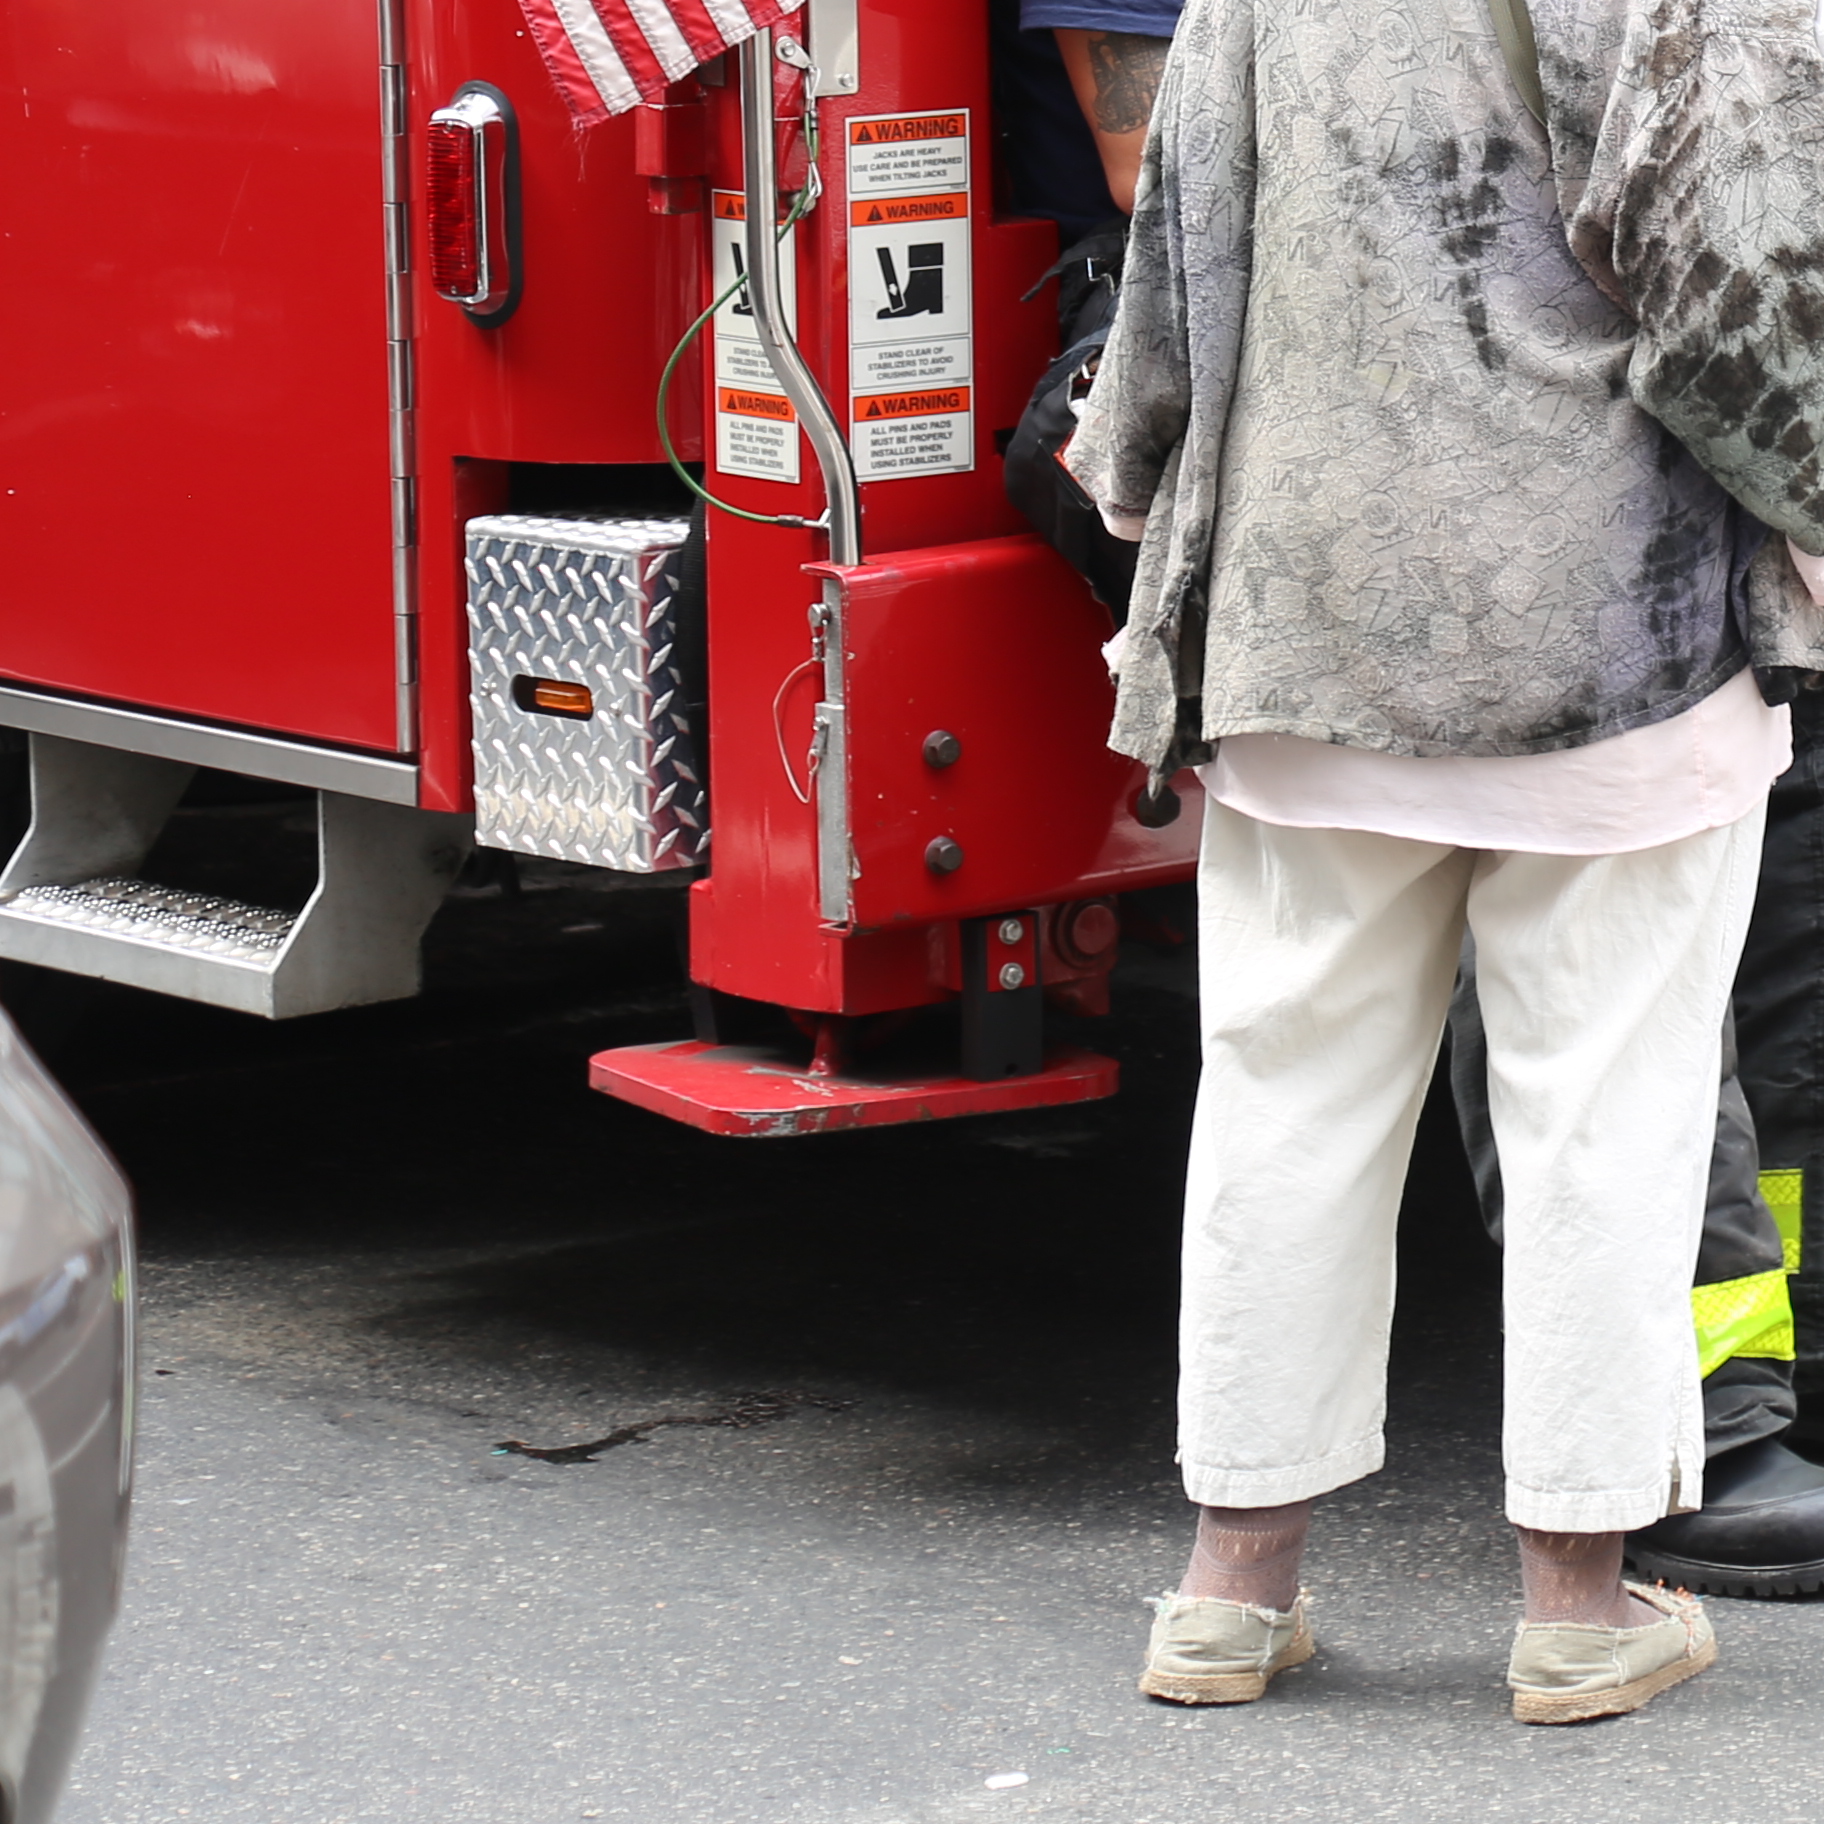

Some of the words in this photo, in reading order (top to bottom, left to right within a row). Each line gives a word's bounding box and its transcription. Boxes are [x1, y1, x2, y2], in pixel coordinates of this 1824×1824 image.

[875, 118, 959, 140] WARNING
[873, 150, 898, 160] JACKS
[899, 149, 915, 158] ARE
[917, 147, 942, 156] HEAVY
[853, 164, 868, 173] USE
[870, 162, 891, 171] CARE
[893, 160, 909, 169] AND
[911, 159, 921, 168] BE
[922, 156, 963, 167] PREPARED
[869, 174, 891, 183] WHEN
[893, 171, 921, 180] TILTING
[922, 169, 947, 179] JACKS
[886, 201, 955, 218] WARNING
[878, 350, 904, 360] STAND
[905, 348, 932, 358] CLEAR
[933, 346, 944, 356] OF
[868, 360, 917, 371] STABILIZERS
[918, 358, 930, 367] TO
[930, 356, 954, 365] AVOID
[877, 370, 917, 381] CRUSHING
[918, 367, 947, 377] INJURY
[737, 395, 788, 416] WARNING
[883, 392, 960, 414] WARNING
[871, 426, 886, 436] ALL
[888, 425, 908, 434] PINS
[909, 422, 928, 432] AND
[929, 420, 952, 430] PADS
[871, 437, 894, 447] MUST
[896, 436, 907, 445] BE
[909, 431, 954, 445] PROPERLY
[870, 446, 916, 458] INSTALLED
[918, 443, 943, 453] WHEN
[870, 459, 897, 469] USING
[898, 453, 952, 467] STABILIZERS
